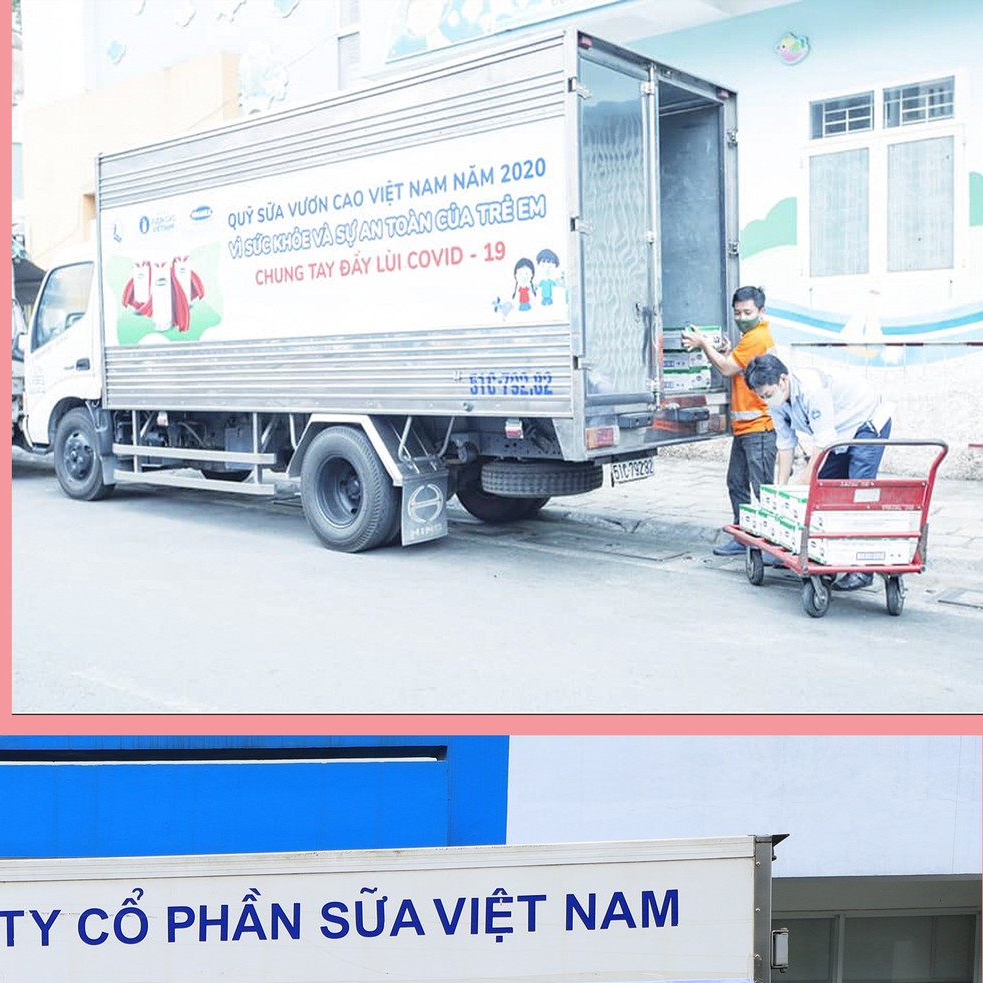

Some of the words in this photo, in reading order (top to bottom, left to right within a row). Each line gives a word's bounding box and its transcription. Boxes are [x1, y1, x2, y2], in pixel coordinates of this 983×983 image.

[228, 205, 254, 230] QUỸ
[257, 201, 284, 223] SỮA
[333, 190, 364, 210] CAO
[368, 180, 404, 206] VIỆT
[409, 175, 447, 198] NAM
[453, 165, 494, 191] NĂM
[500, 157, 546, 183] 2020
[244, 233, 271, 257] SỨC
[273, 226, 311, 253] KHỎE
[312, 222, 334, 248] VÀ
[335, 219, 358, 248] SỰ
[359, 219, 383, 241] AN
[385, 209, 433, 238] TOÀN
[435, 202, 475, 231] CỦA
[476, 194, 514, 226] TRẺ
[517, 194, 546, 221] EM
[255, 264, 304, 286] CHUNG
[308, 261, 335, 280] TAY
[339, 250, 372, 277] ĐẨY
[377, 249, 401, 273] LÙI
[407, 246, 463, 270] COVID
[484, 241, 506, 262] 19
[77, 887, 149, 947] CỔ
[167, 887, 301, 944] PHẦN
[320, 887, 425, 941] SỮA
[433, 887, 547, 943] VIỆT
[565, 889, 679, 932] NAM
